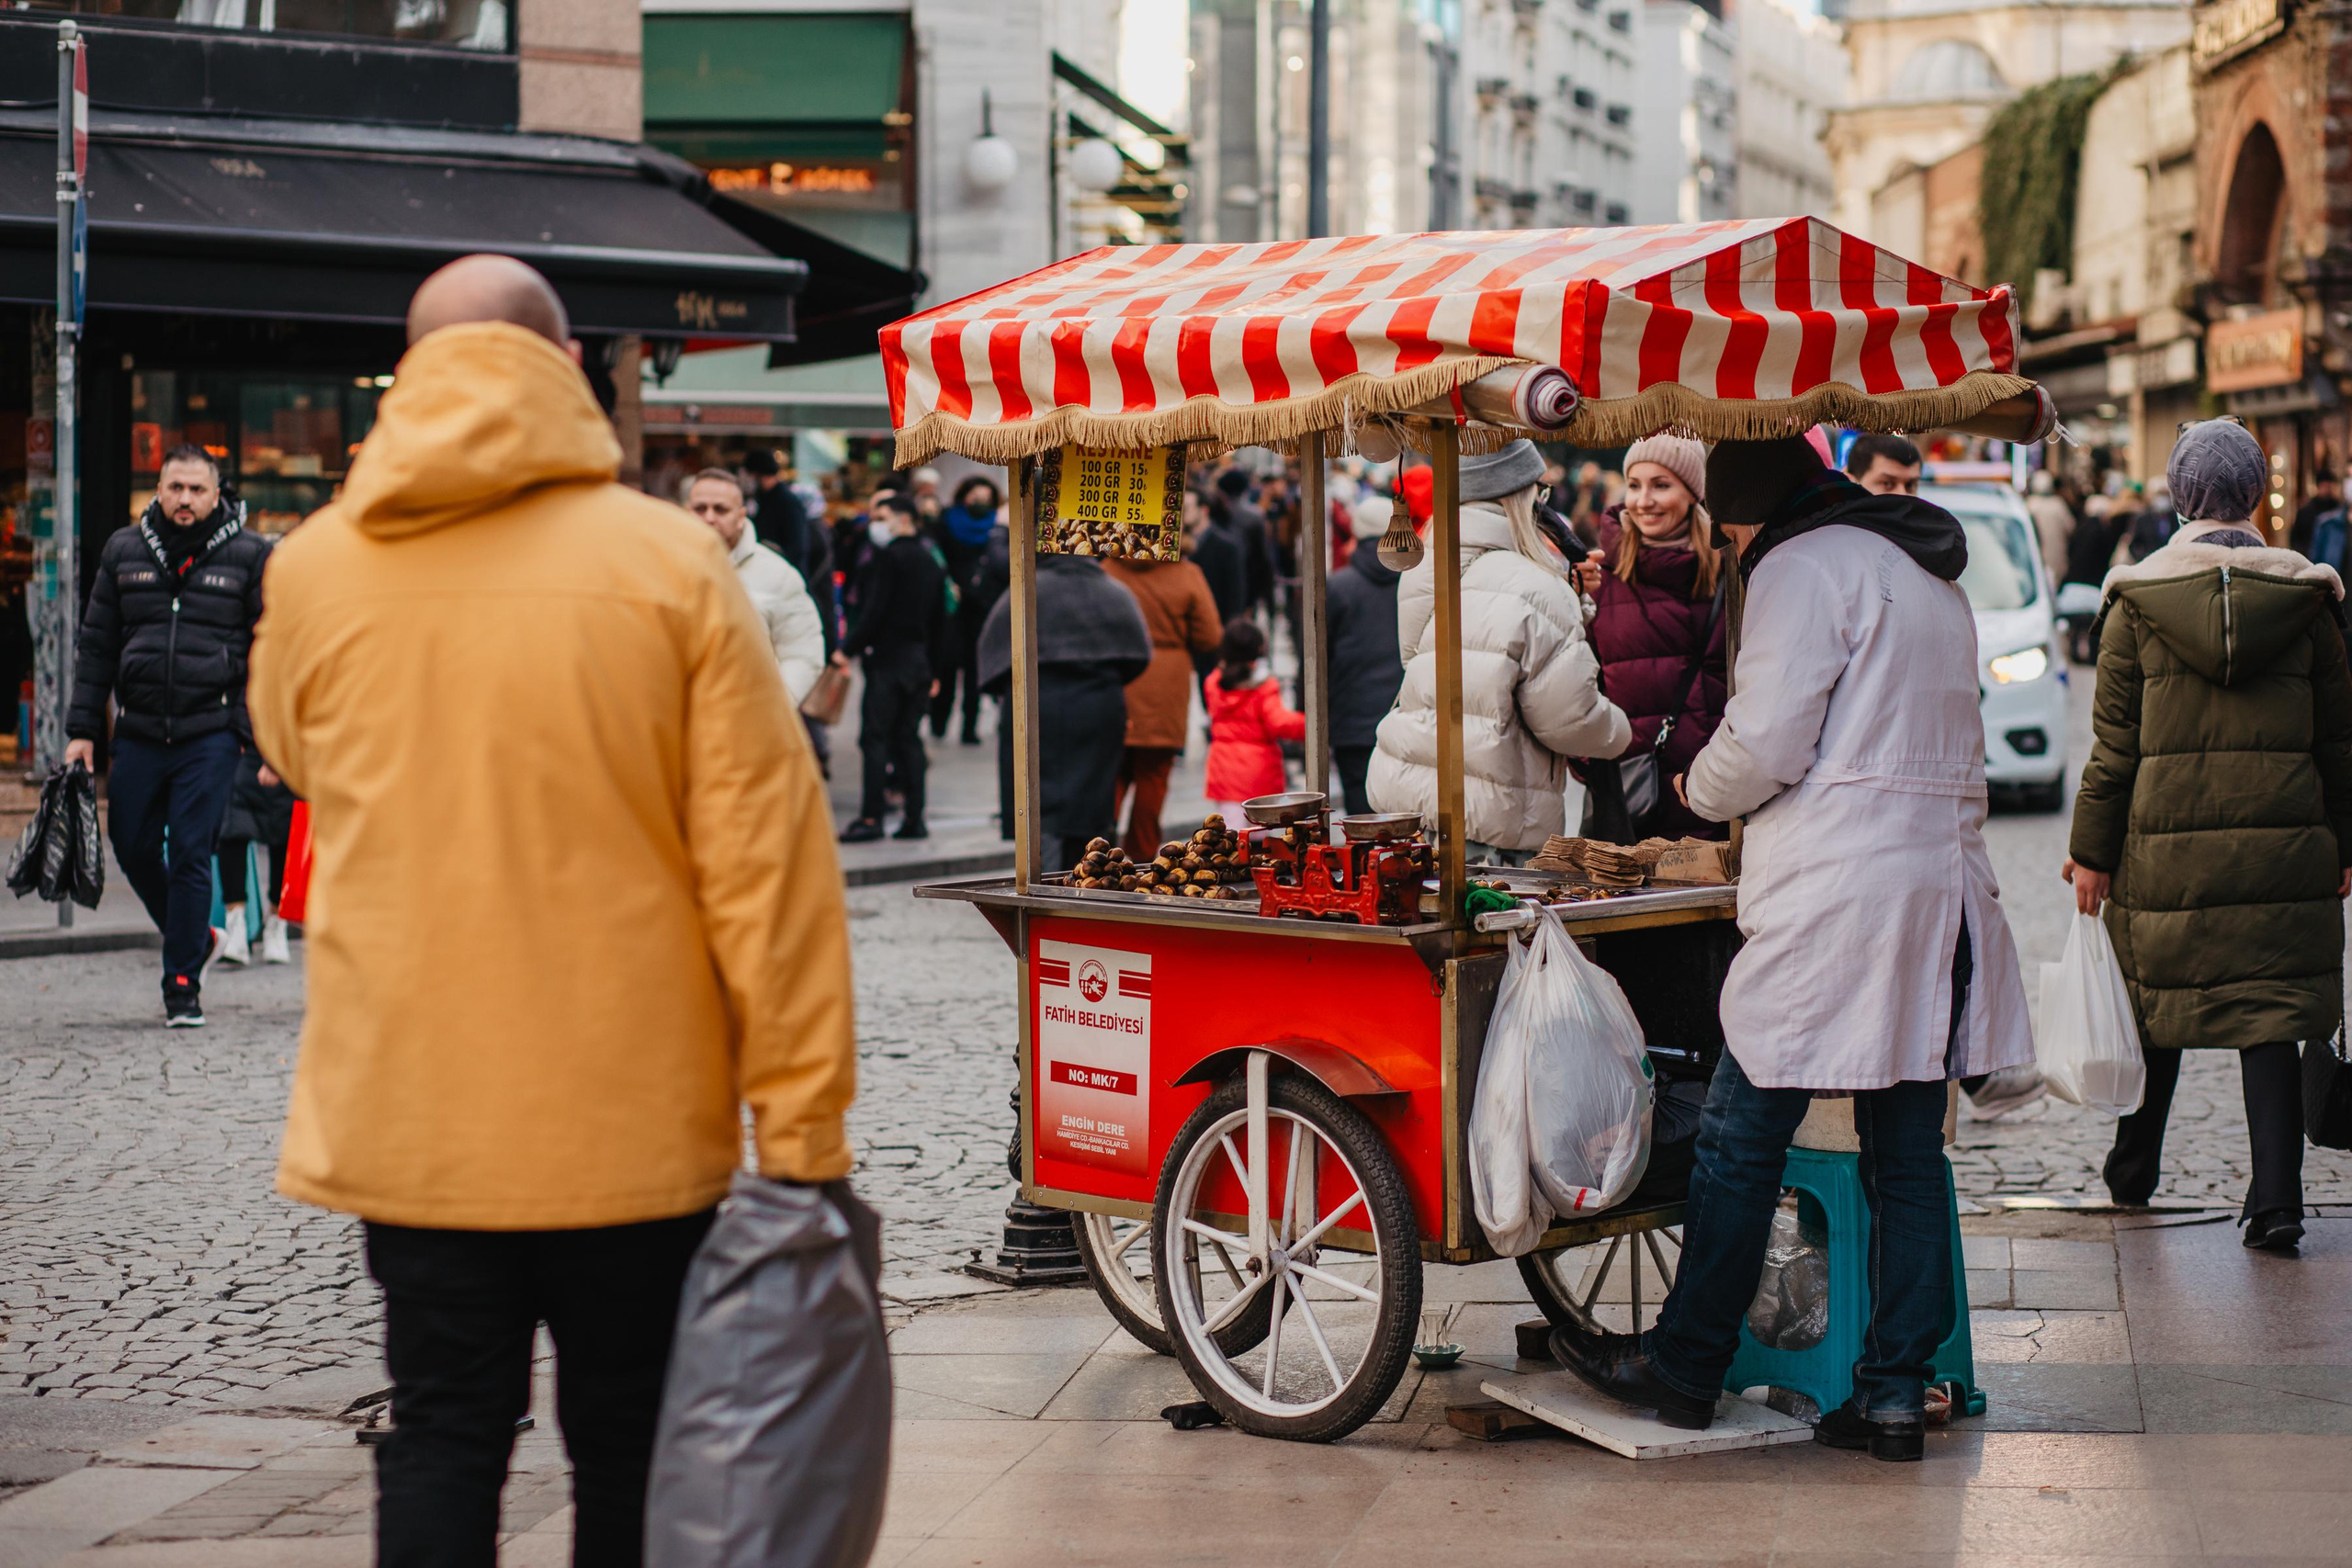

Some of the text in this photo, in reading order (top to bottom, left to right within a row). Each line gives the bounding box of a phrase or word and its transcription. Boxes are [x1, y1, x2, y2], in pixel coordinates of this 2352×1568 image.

[1081, 460, 1102, 473] 100
[1104, 461, 1121, 474] GR
[1080, 475, 1101, 488] 200
[1104, 476, 1120, 489] GR
[1079, 490, 1100, 502] 300
[1102, 491, 1119, 503] GR
[1077, 505, 1098, 517] 400
[1102, 506, 1117, 519] GR
[1045, 1004, 1143, 1035] FATİH BELEDİYESİ
[1069, 1068, 1119, 1089] NO: MK/7
[1061, 1114, 1125, 1137] ENGİN DERE
